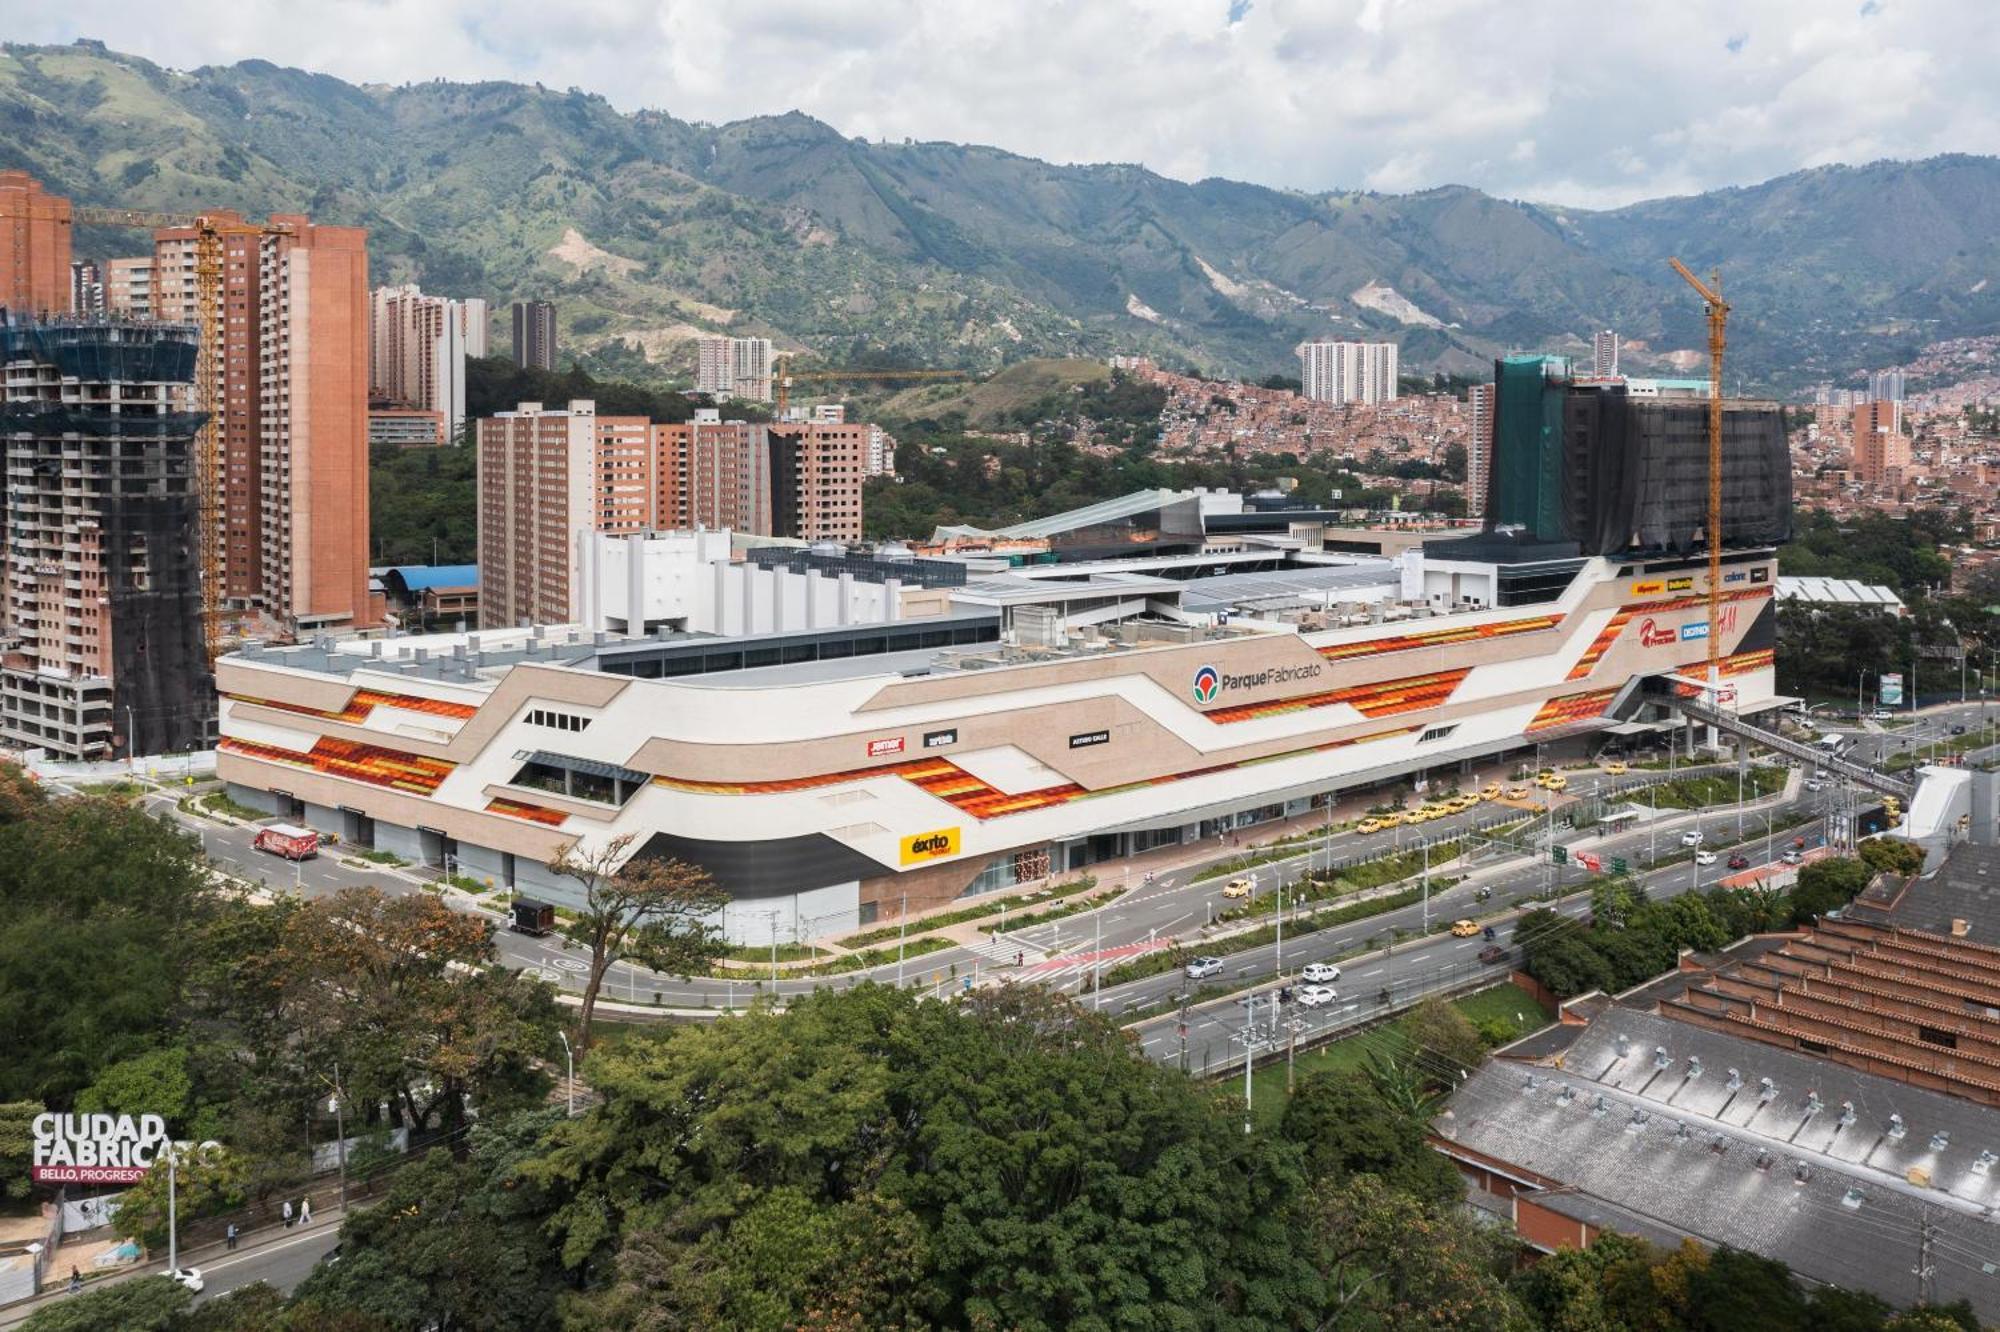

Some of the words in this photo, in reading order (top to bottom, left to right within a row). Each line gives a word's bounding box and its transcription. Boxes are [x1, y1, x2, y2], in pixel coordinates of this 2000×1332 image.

[1222, 664, 1321, 690] ParqueFabricato
[32, 1113, 165, 1142] CIUDAD
[40, 1169, 78, 1181] BELLO,
